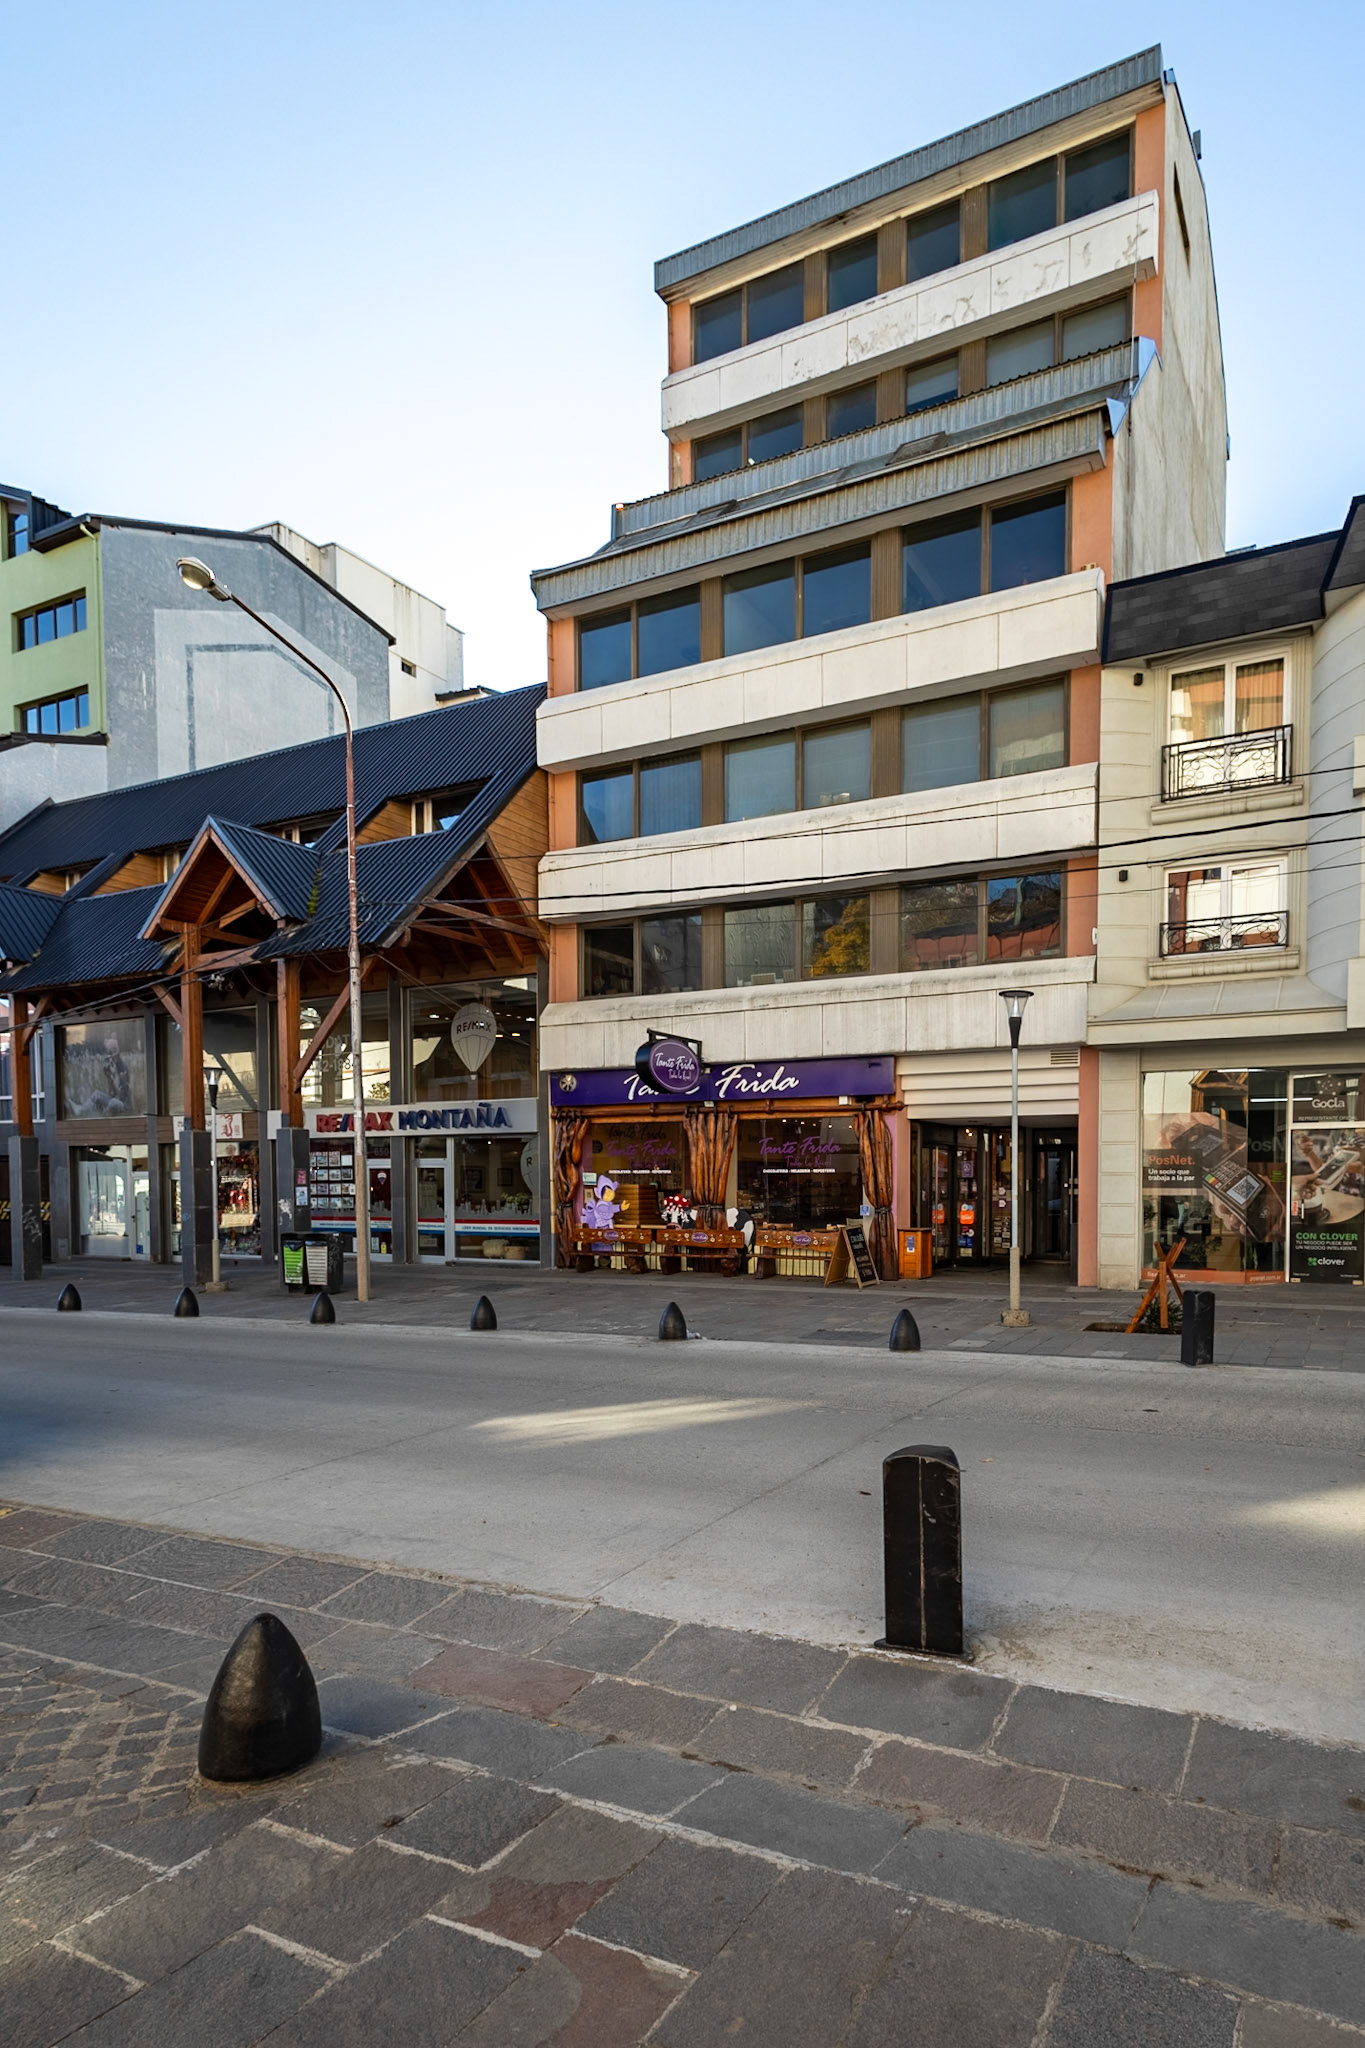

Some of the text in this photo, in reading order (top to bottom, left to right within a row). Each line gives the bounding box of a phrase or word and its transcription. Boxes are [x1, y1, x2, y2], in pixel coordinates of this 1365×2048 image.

[457, 1020, 491, 1034] RE/MAX
[655, 1053, 695, 1070] Tante Frida
[715, 1064, 799, 1099] Frida
[1312, 1097, 1345, 1108] GoCla
[398, 1103, 512, 1131] MONTAÑA
[642, 1139, 677, 1157] Frida
[759, 1136, 841, 1155] Tante Frida
[1148, 1155, 1195, 1165] PosNet.
[1296, 1232, 1317, 1240] CON
[1317, 1257, 1345, 1266] clover
